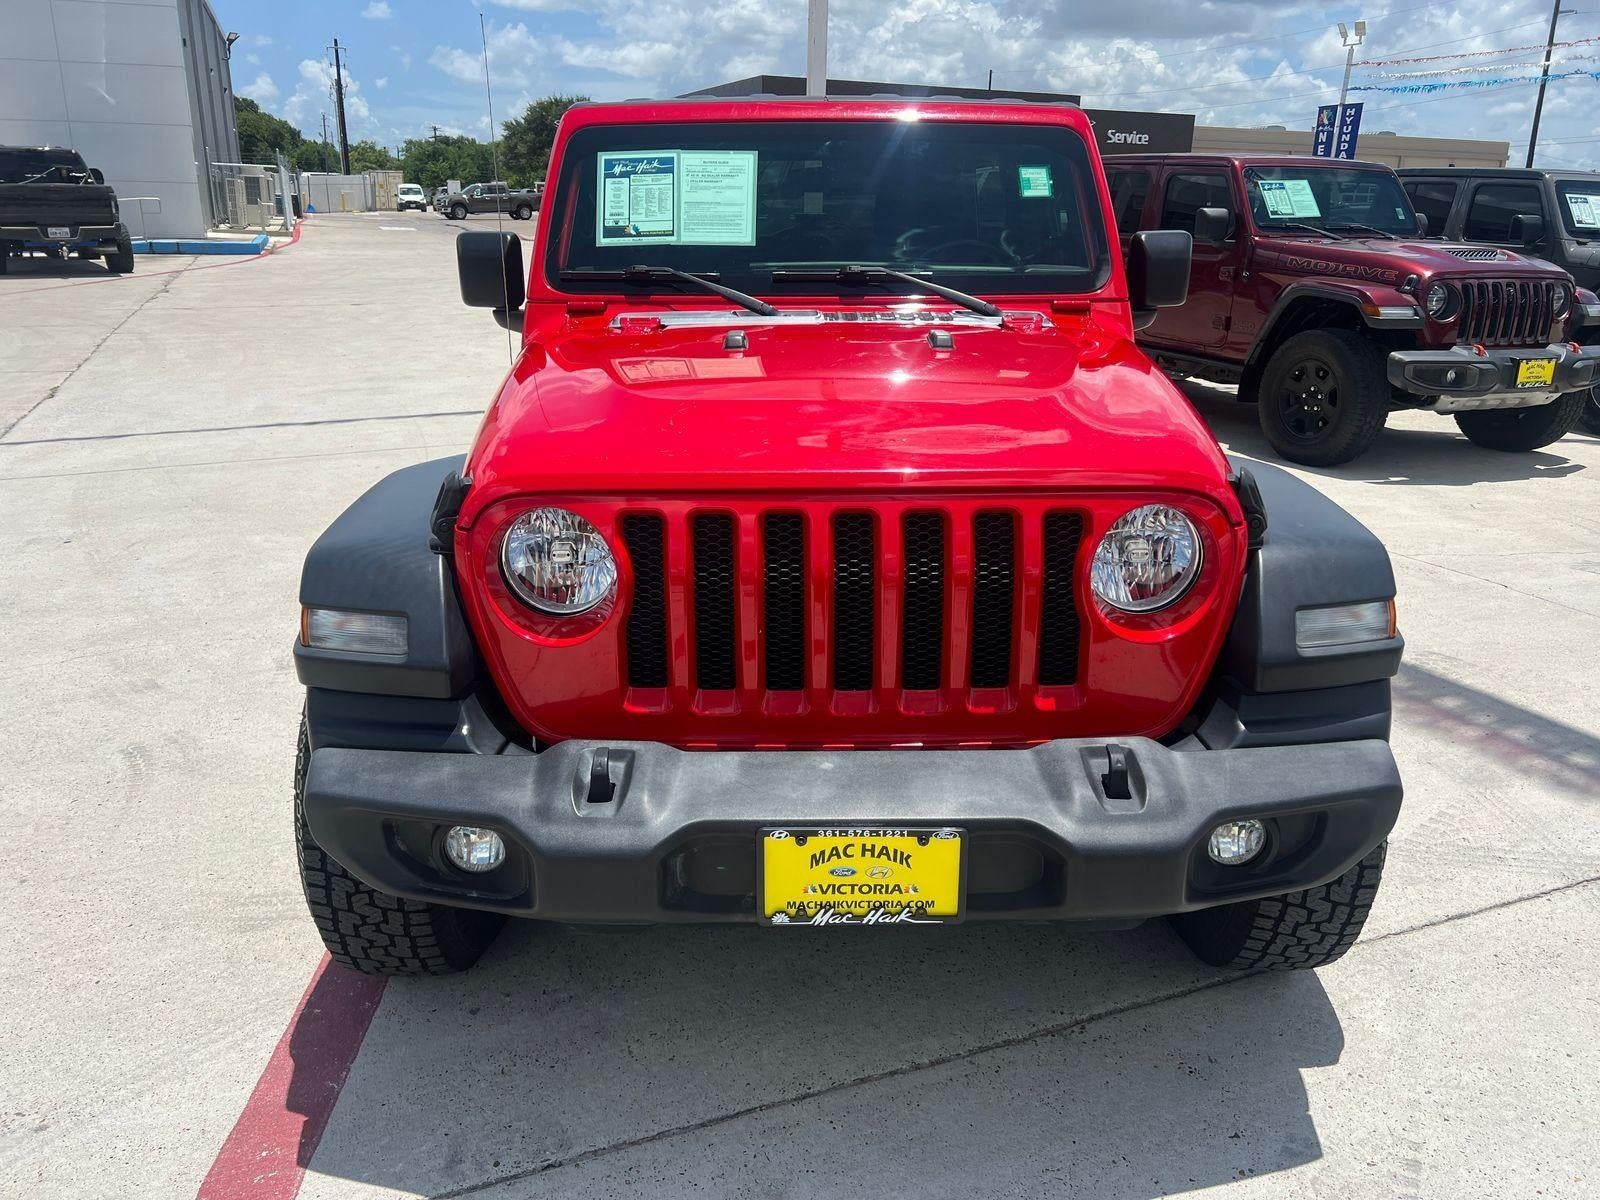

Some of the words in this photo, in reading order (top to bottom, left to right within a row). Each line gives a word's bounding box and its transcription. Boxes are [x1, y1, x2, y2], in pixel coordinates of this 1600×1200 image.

[1106, 130, 1149, 145] Service
[612, 164, 635, 176] Mac
[635, 158, 660, 173] Haik
[1286, 256, 1399, 281] MOJAVE
[817, 830, 909, 838] 361-576-1221
[809, 843, 855, 870] MAC
[861, 843, 912, 869] HAIK
[818, 883, 904, 895] VICTORIA
[786, 900, 935, 910] MACHAIKVICTORIA.COM
[808, 908, 856, 925] Mac
[861, 907, 914, 925] Haik
